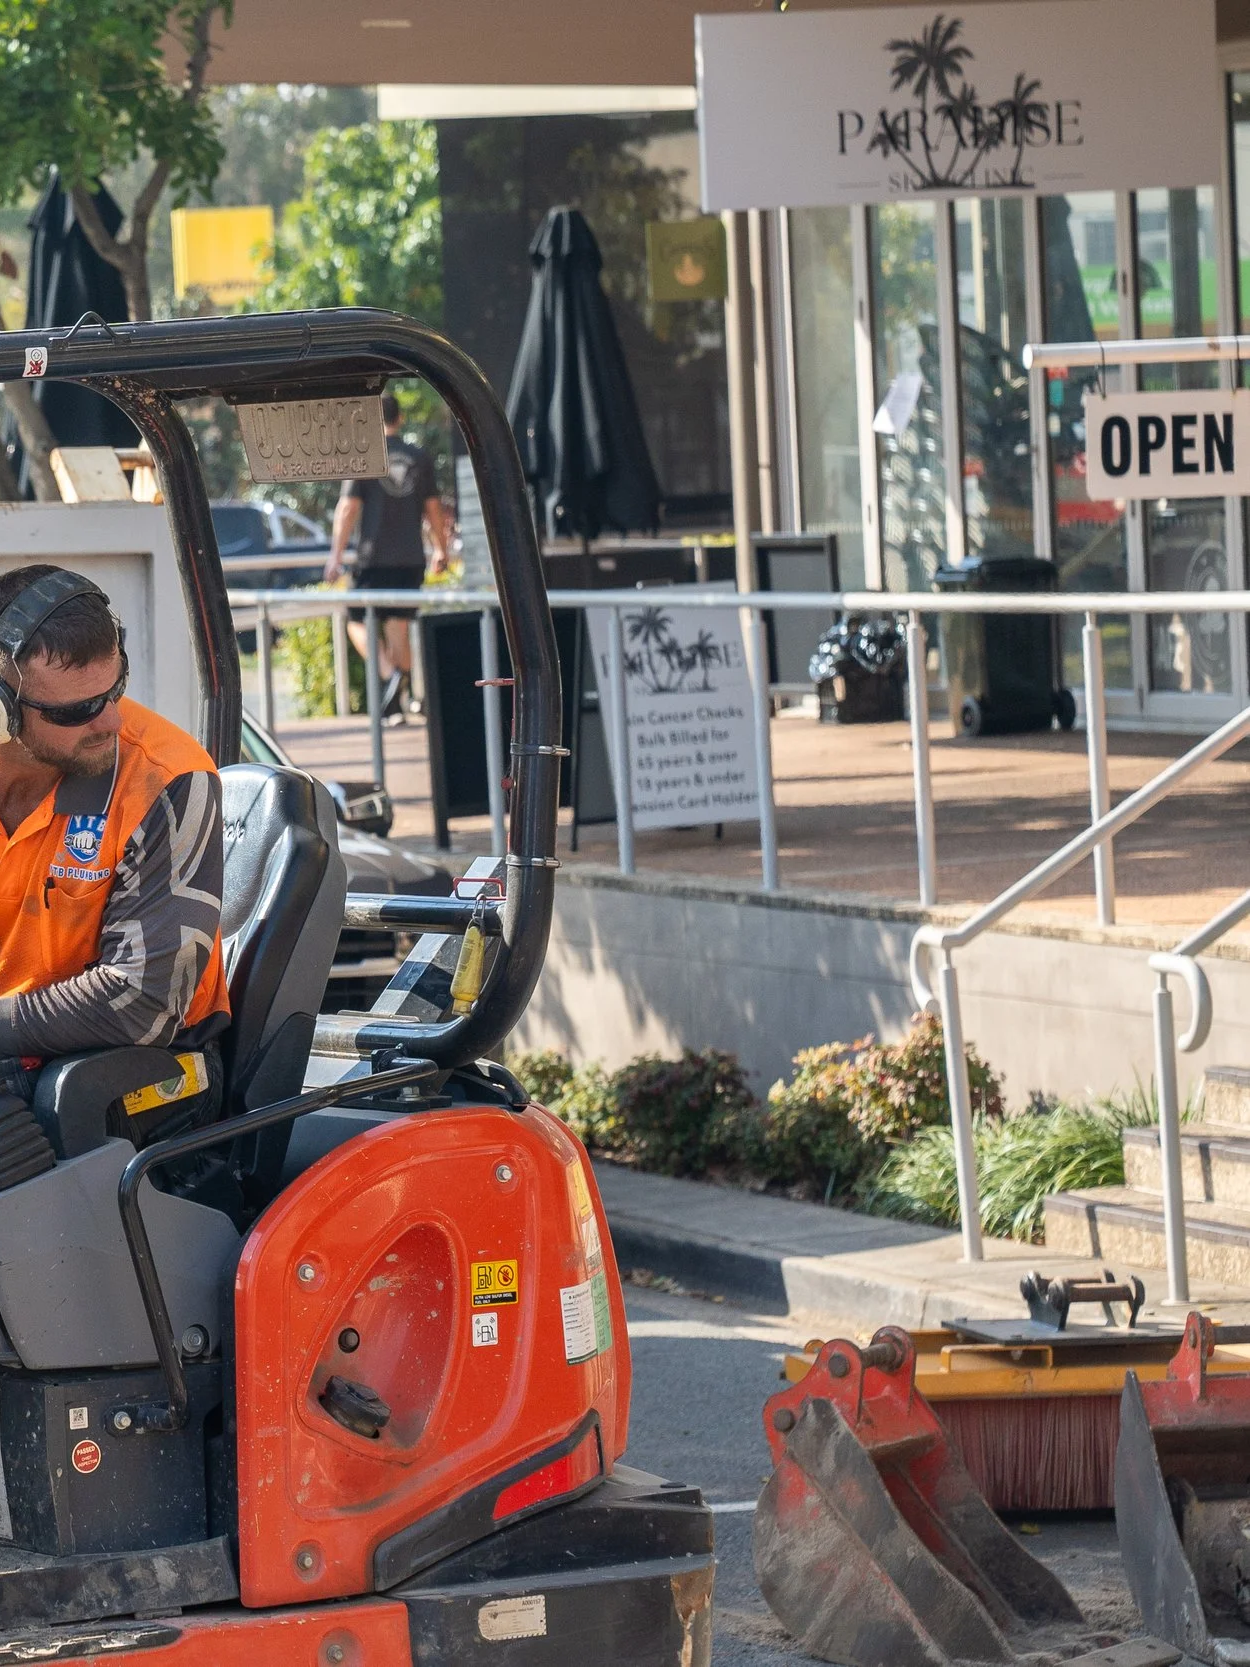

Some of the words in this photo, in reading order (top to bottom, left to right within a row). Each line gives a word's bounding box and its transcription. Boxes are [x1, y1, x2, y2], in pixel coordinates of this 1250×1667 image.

[1101, 412, 1234, 476] OPEN
[647, 710, 694, 725] Cancer
[696, 705, 744, 721] Checks
[637, 731, 666, 748] Bulk
[669, 729, 709, 745] Billed
[712, 728, 730, 741] for
[656, 756, 692, 774] years
[695, 750, 705, 765] &
[708, 751, 737, 764] over
[655, 776, 691, 795] years
[694, 771, 703, 787] &
[706, 770, 745, 785] under
[632, 799, 674, 813] ension
[677, 794, 709, 810] Card
[74, 815, 106, 832] YTB
[76, 1445, 96, 1455] PASSED
